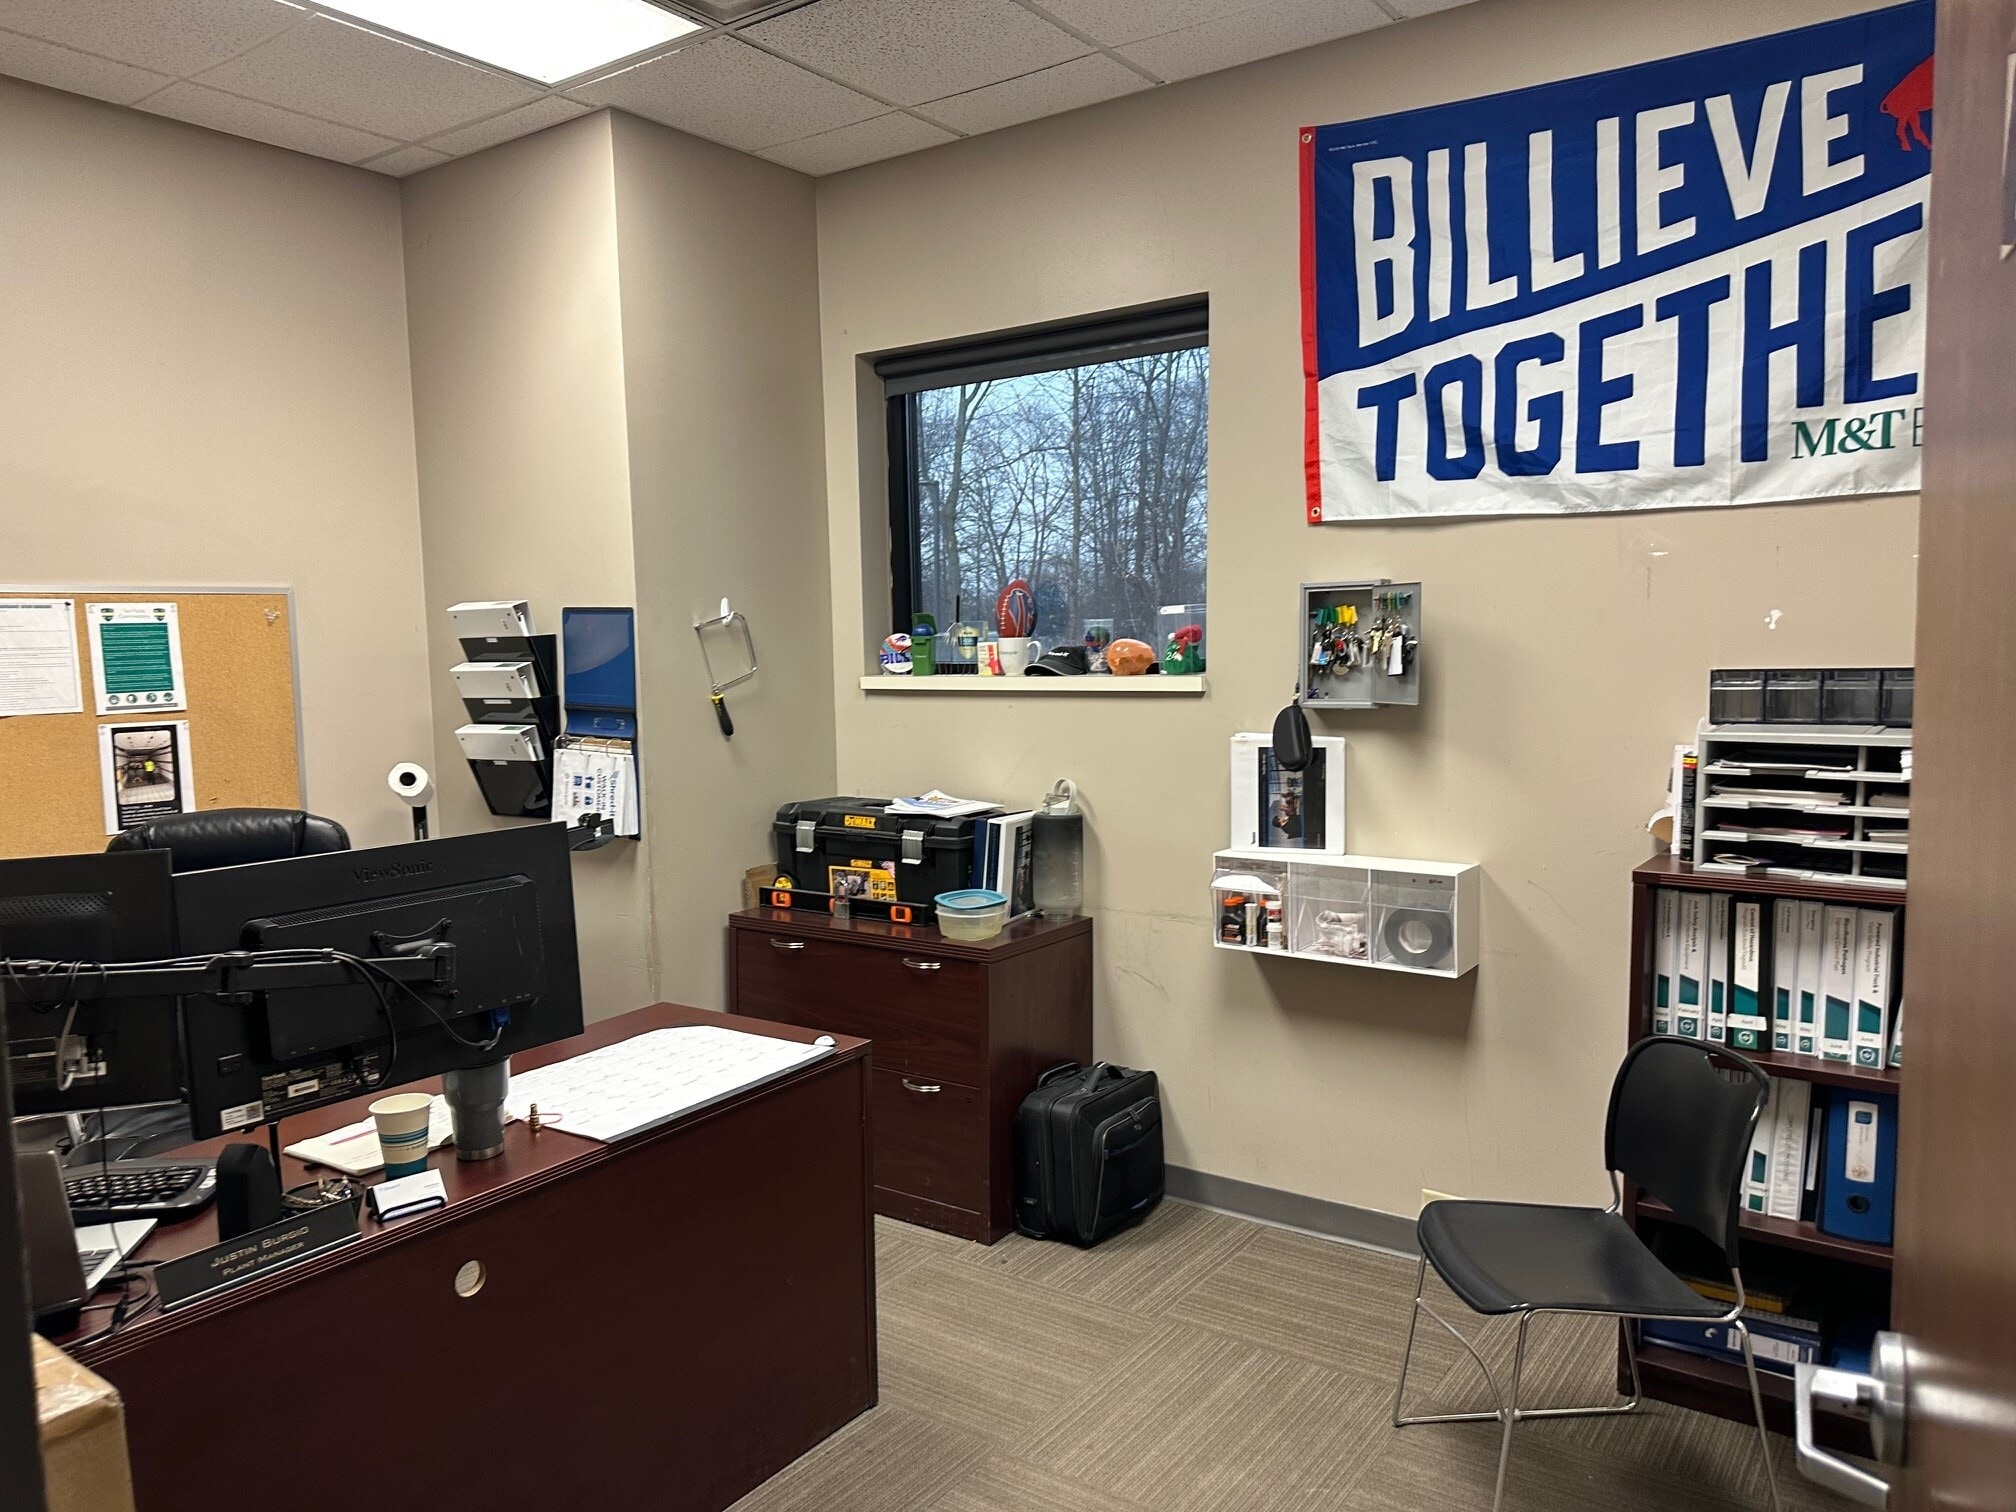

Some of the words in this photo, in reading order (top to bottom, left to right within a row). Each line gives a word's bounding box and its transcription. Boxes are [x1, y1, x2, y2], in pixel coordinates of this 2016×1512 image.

[1352, 63, 1865, 348] BILLIEVE
[1357, 202, 1923, 482] TOGETHE
[1790, 408, 1906, 460] M&T
[609, 779, 617, 817] Shred-it
[353, 860, 434, 883] ViewSonic
[1875, 922, 1883, 947] Powered
[1678, 1007, 1700, 1015] February
[210, 1244, 259, 1268] JUSTIN
[261, 1225, 310, 1250] BURGIO
[222, 1259, 255, 1277] PLANT
[257, 1241, 305, 1264] MANAGER
